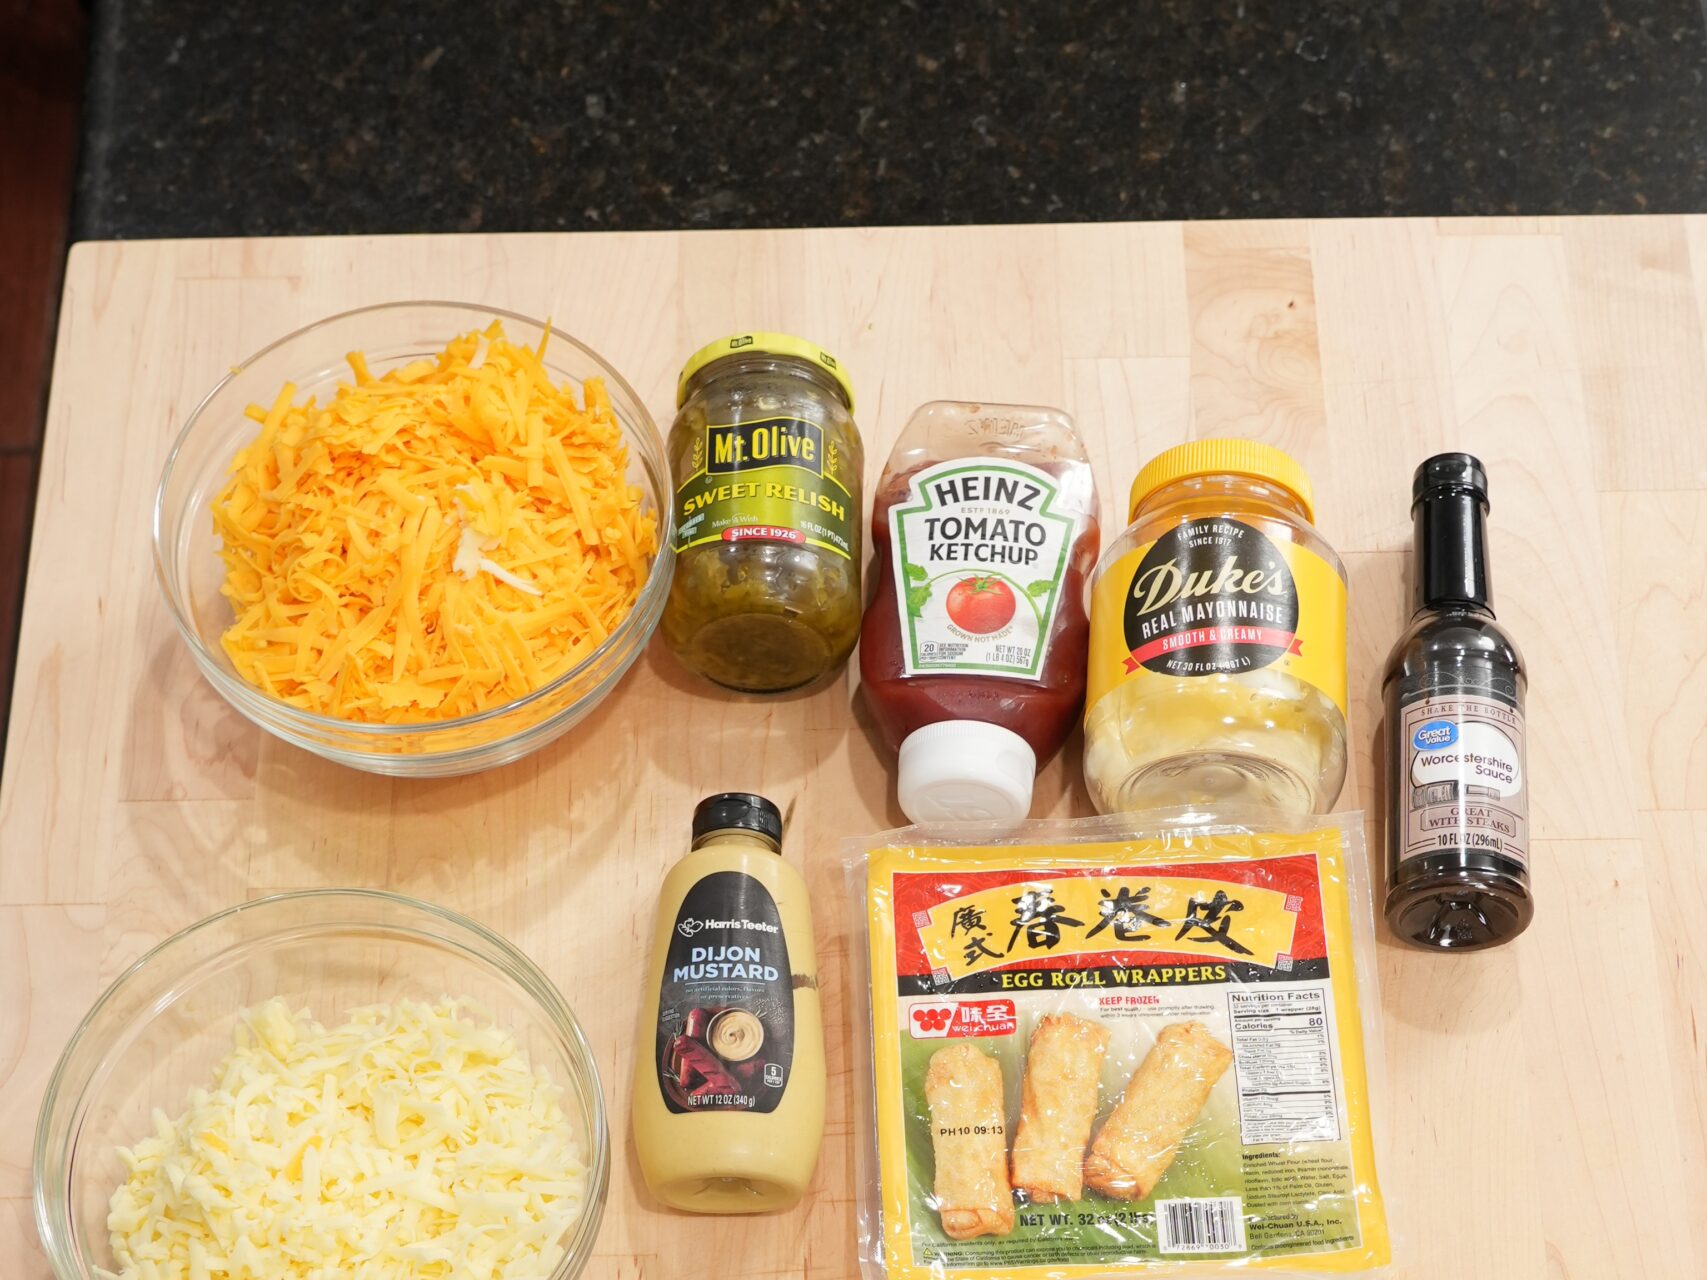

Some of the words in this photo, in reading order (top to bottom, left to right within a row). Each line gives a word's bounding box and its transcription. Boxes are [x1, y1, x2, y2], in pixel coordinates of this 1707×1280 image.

[715, 433, 749, 464] Mt.
[752, 425, 815, 461] Olive
[934, 476, 1041, 511] HEINZ
[683, 482, 761, 516] SWEET
[765, 482, 845, 521] RELISH
[987, 507, 1011, 515] 1869
[731, 527, 767, 537] SINCE
[770, 528, 797, 539] 1926
[924, 517, 1047, 547] TOMATO
[1177, 524, 1209, 541] FAMILY
[1212, 524, 1245, 539] RECIPE
[1188, 536, 1213, 548] SINCE
[929, 543, 1039, 566] KETCHUP
[1133, 555, 1287, 617] Duke's
[1141, 610, 1177, 640] REAL
[1181, 600, 1283, 624] MAYONNAISE
[946, 624, 974, 642] GROWN
[974, 635, 987, 643] NOT
[1162, 631, 1206, 651] SMOOTH
[1209, 630, 1217, 641] &
[1220, 628, 1263, 641] CREAMY
[924, 643, 935, 652] 20
[995, 644, 1006, 653] NET
[1006, 646, 1015, 654] WT
[1023, 648, 1031, 657] OZ
[992, 652, 1000, 662] LB
[1166, 659, 1182, 669] NET
[1182, 662, 1193, 671] 30
[1195, 662, 1204, 671] FL
[1205, 662, 1217, 671] OZ
[1241, 656, 1251, 666] L)
[1420, 704, 1453, 717] SHAKE
[1484, 704, 1517, 725] BOTTLE
[1418, 725, 1452, 740] Great
[1425, 735, 1450, 745] Value
[1420, 752, 1513, 773] Worcestershire
[1475, 764, 1513, 784] Sauce
[1450, 807, 1493, 817] GREAT
[1467, 817, 1511, 833] STEAKS
[1437, 834, 1448, 847] 10
[1449, 833, 1459, 845] FL
[1472, 833, 1503, 850] (296mL)
[705, 919, 741, 930] Harris
[741, 919, 779, 934] Teeter
[691, 946, 760, 963] DIJON
[673, 963, 779, 983] MUSTARD
[1001, 972, 1044, 990] EGG
[1051, 968, 1106, 988] ROLL
[1113, 964, 1227, 985] WRAPPERS
[1099, 996, 1123, 1005] KEEP
[1125, 995, 1160, 1005] FROZEN
[1232, 993, 1284, 1003] Nutrition
[1287, 992, 1321, 1001] Facts
[1309, 1017, 1323, 1027] 80
[770, 1066, 777, 1076] 5
[687, 1094, 702, 1106] NET
[702, 1094, 714, 1105] WT
[715, 1094, 723, 1105] 12
[723, 1094, 733, 1104] OZ
[733, 1094, 748, 1105] (340
[748, 1095, 756, 1108] g)
[940, 1127, 956, 1136] PH
[959, 1126, 970, 1135] 10
[974, 1125, 1003, 1135] 09:13
[1242, 1152, 1280, 1161] Ingredients:
[1020, 1214, 1045, 1227] NET
[1049, 1213, 1074, 1226] WT.
[1078, 1213, 1095, 1225] 32
[1097, 1215, 1112, 1225] oz
[1249, 1221, 1294, 1231] Wei-Chuan
[1296, 1219, 1324, 1228] U.S.A.,
[1249, 1232, 1263, 1240] Bell
